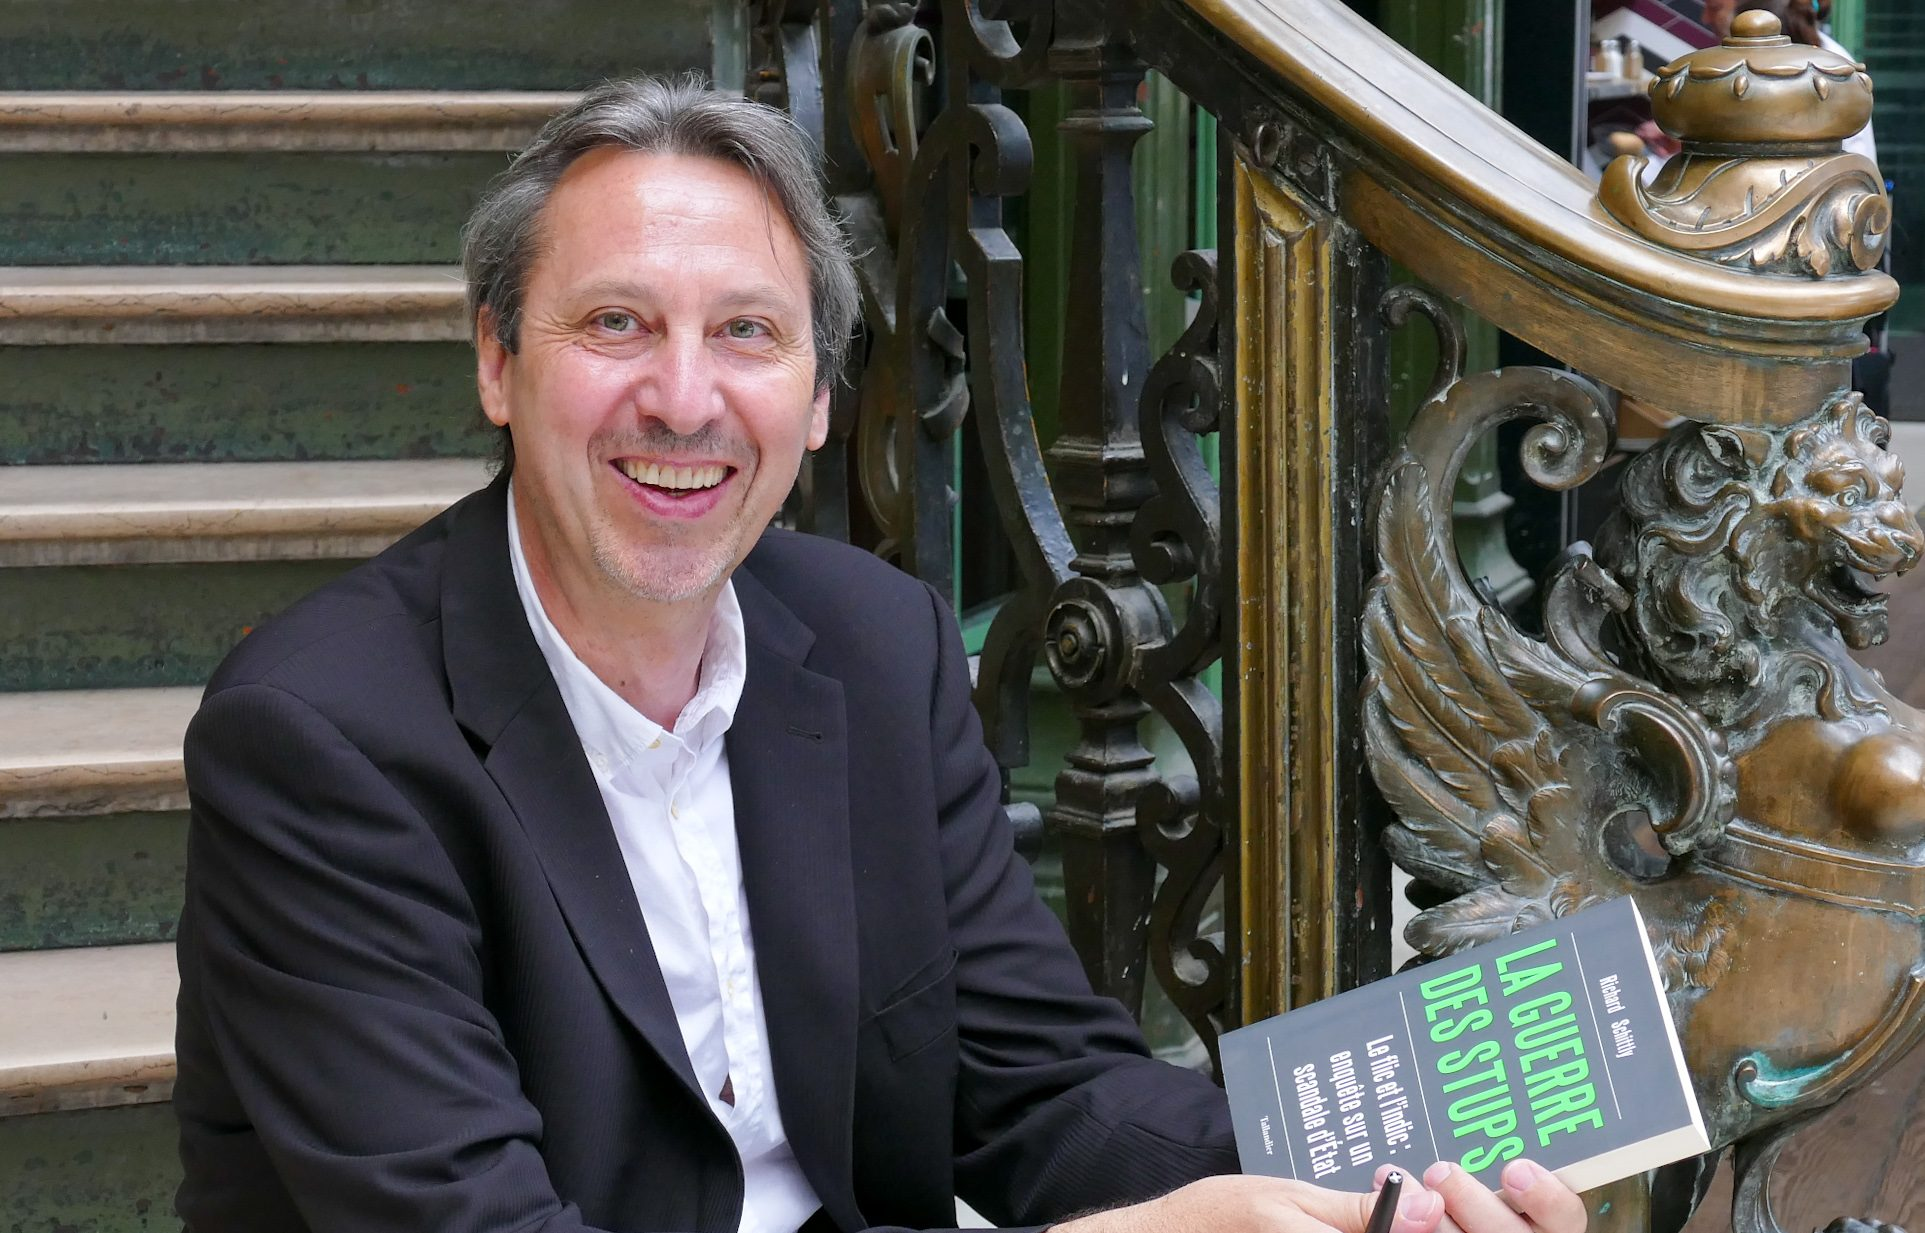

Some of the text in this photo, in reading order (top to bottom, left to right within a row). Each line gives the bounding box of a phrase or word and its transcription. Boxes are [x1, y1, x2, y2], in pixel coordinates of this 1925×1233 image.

[1365, 1033, 1394, 1058] Le
[1496, 939, 1605, 1147] LA GUERRE
[1598, 973, 1637, 1059] Richard Schittly
[1329, 1049, 1374, 1167] enquête sur un
[1369, 1054, 1401, 1083] flic
[1375, 1079, 1405, 1102] et
[1420, 964, 1525, 1174] DES STUPS
[1259, 1115, 1273, 1156] Tallandier
[1293, 1063, 1344, 1180] scandale d'État
